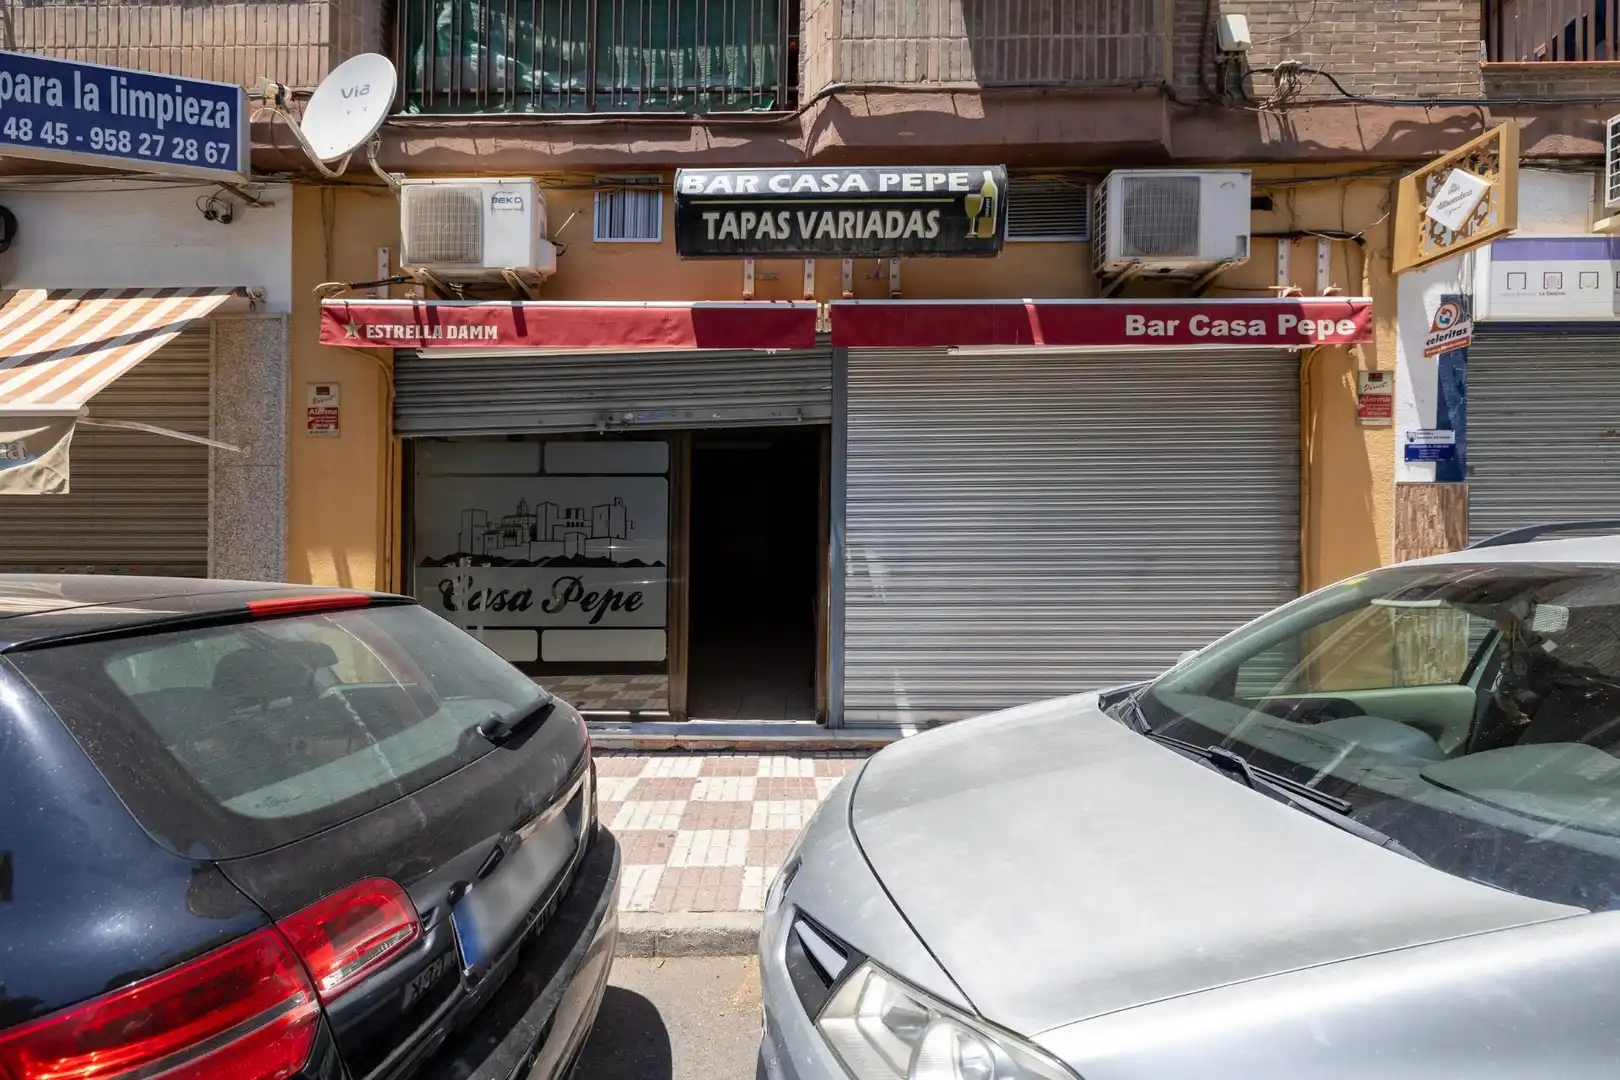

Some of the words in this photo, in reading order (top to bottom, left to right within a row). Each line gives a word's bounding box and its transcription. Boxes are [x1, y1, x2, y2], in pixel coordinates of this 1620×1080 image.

[0, 70, 62, 109] para
[74, 70, 100, 112] la
[110, 75, 231, 130] limpieza
[3, 116, 33, 142] 48
[40, 121, 69, 146] 45
[90, 126, 132, 153] 958
[138, 132, 165, 157] 27
[171, 137, 199, 161] 28
[204, 141, 230, 164] 67
[680, 174, 761, 194] BAR
[768, 173, 872, 193] CASA
[879, 172, 970, 192] PEPE
[702, 210, 793, 240] TAPAS
[797, 209, 940, 240] VARIADAS
[366, 324, 443, 339] ESTRELLA
[446, 325, 498, 340] DAMM
[1125, 314, 1180, 336] Bar
[1189, 314, 1267, 336] Casa
[1277, 314, 1357, 341] Pepe
[1426, 327, 1468, 346] celeritas
[438, 575, 534, 613] Casa
[541, 575, 645, 625] Pepe
